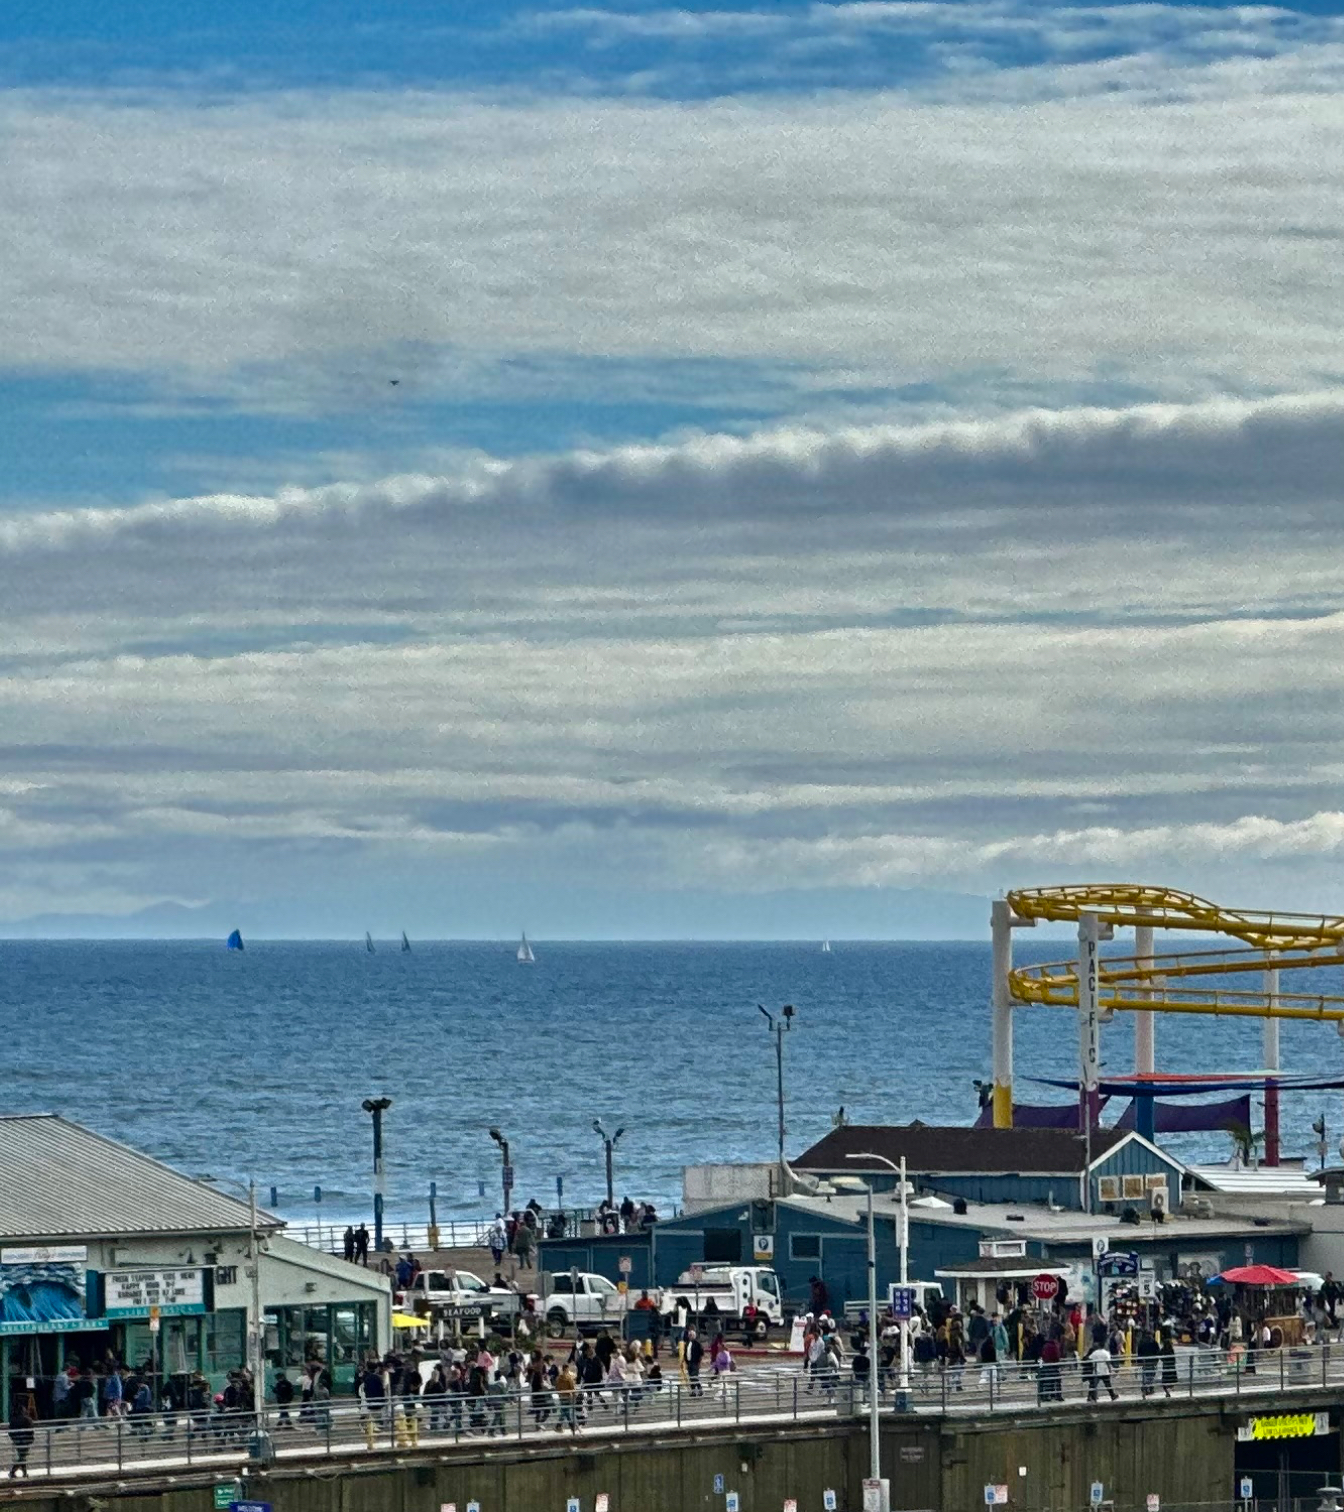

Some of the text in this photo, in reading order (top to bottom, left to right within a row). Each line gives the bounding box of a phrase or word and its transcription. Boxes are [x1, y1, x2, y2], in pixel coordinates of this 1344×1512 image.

[1087, 941, 1096, 1064] PACIFIC
[1033, 1281, 1057, 1292] STOP
[443, 1306, 482, 1317] SEAFOOD
